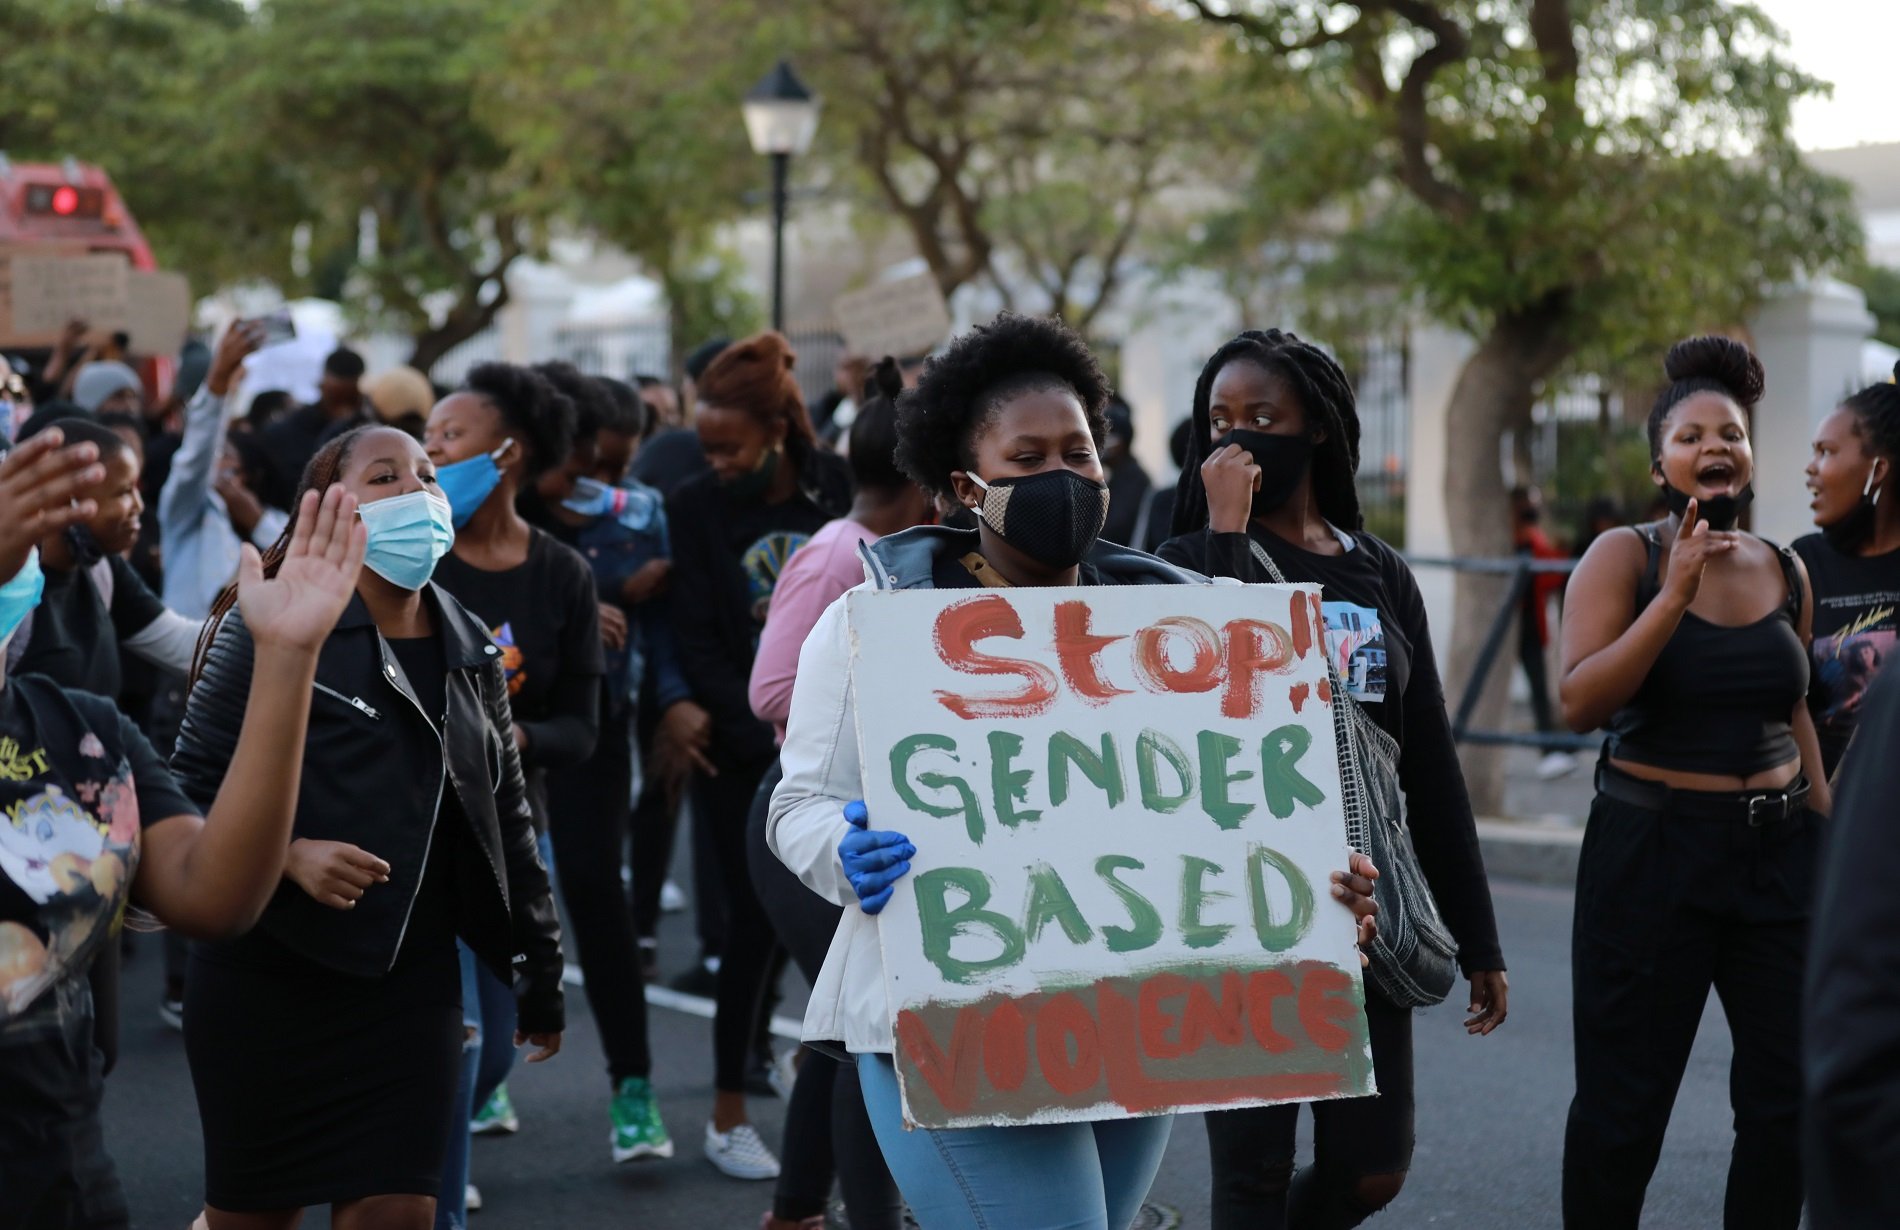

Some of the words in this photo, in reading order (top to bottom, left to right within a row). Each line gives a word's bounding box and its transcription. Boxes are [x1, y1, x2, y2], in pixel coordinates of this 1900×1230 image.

[888, 724, 1326, 844] GENDER
[912, 841, 1317, 985] BASED
[897, 969, 1357, 1112] VIOLENCE
